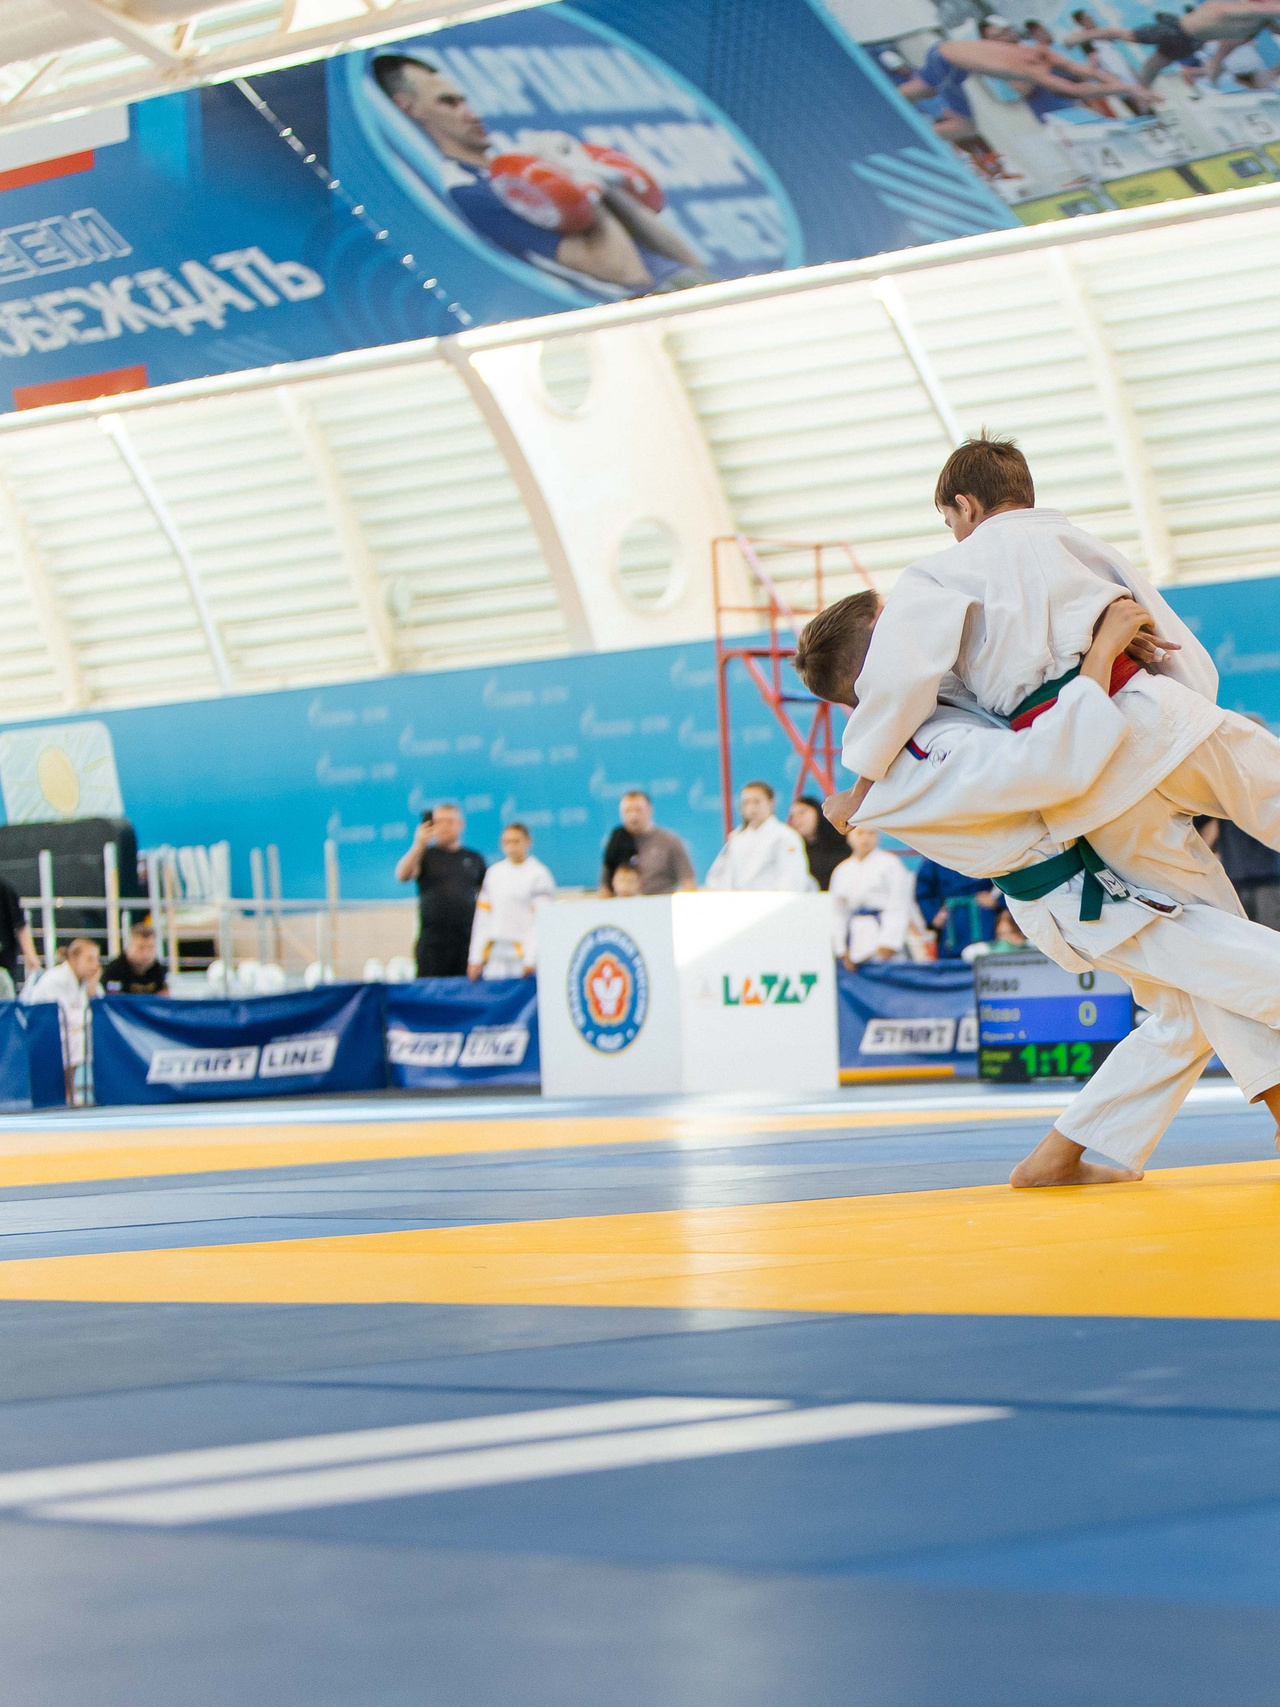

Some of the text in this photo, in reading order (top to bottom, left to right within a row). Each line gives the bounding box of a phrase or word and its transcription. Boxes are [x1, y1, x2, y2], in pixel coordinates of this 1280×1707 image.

[1246, 113, 1275, 135] 5
[1101, 148, 1124, 170] 4
[1079, 969, 1096, 992] 0
[1078, 1001, 1098, 1027] 0
[871, 1025, 948, 1045] START
[157, 1047, 324, 1075] START LINE
[1019, 1042, 1093, 1076] 1:12
